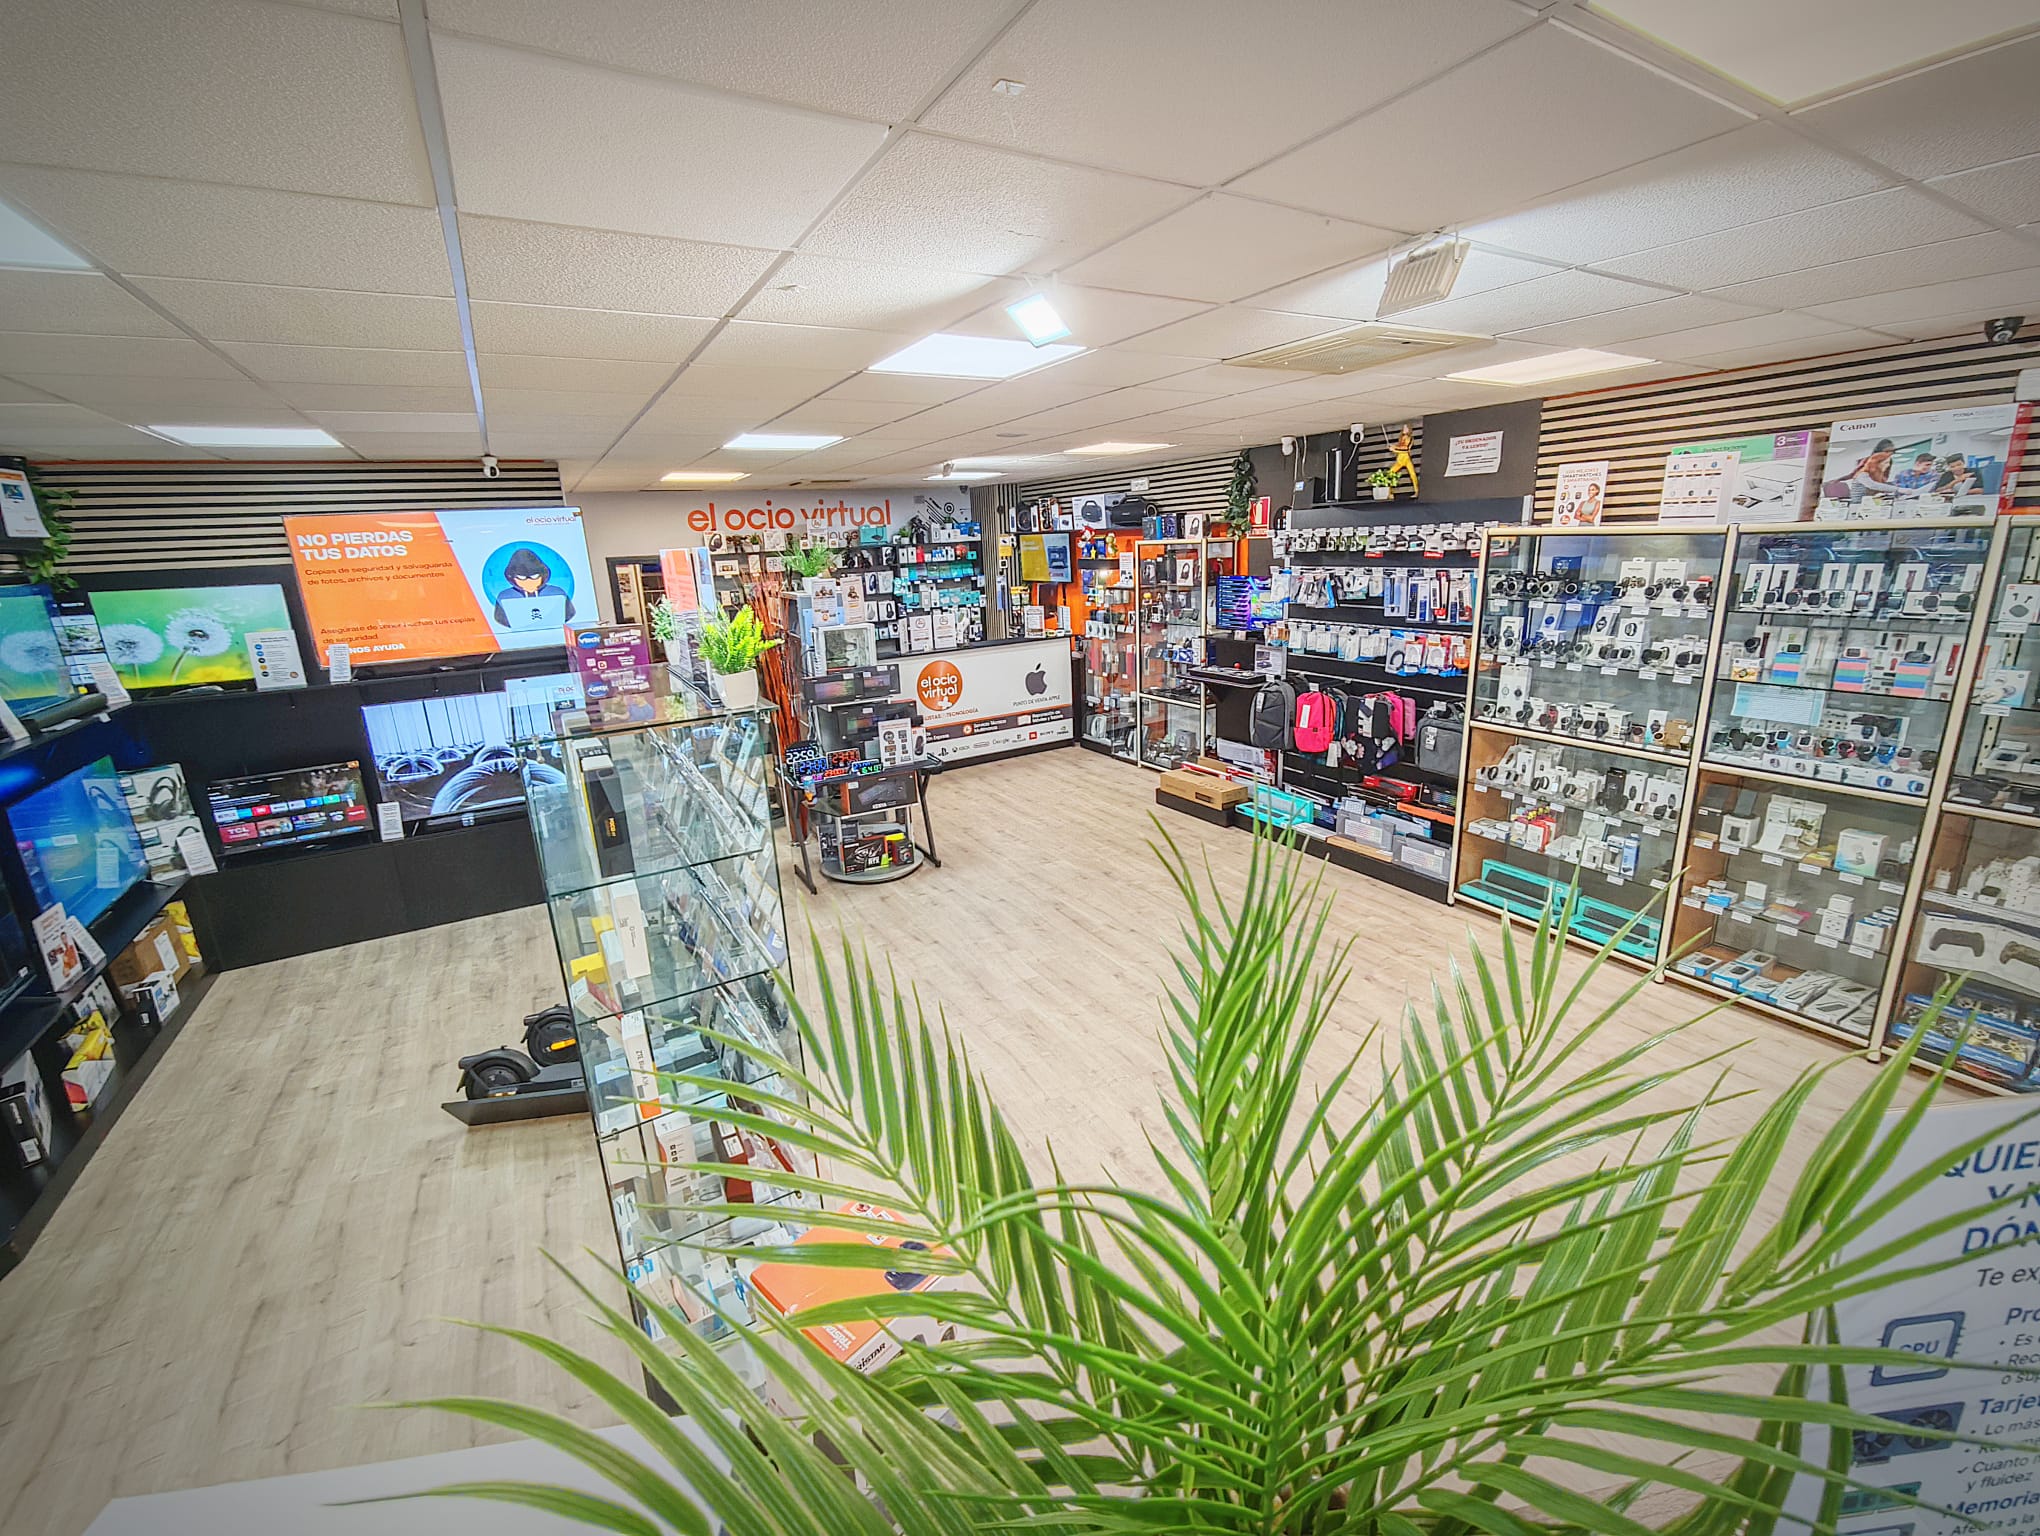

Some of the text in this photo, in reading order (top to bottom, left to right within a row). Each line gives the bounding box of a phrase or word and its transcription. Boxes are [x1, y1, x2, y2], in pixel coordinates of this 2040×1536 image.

[1839, 422, 1877, 433] Canon
[1776, 435, 1787, 447] 3
[687, 498, 893, 532] el ocio virtual
[296, 530, 414, 548] NO PIERDAS
[300, 544, 409, 561] TUS DATOS
[304, 568, 337, 577] Copias
[338, 567, 350, 575] de
[352, 565, 394, 575] seguridad
[403, 562, 454, 571] salvaguarda
[348, 574, 384, 583] archivos
[392, 572, 445, 581] documentos
[367, 623, 378, 631] de
[322, 633, 378, 645] de seguridad
[373, 642, 406, 653] AYUDA
[920, 673, 958, 688] el ocio
[922, 685, 958, 699] virtual
[227, 827, 249, 835] TCL
[1944, 1140, 2040, 1178] QUIE
[1962, 1215, 2040, 1255] DÓN
[1977, 1265, 2040, 1288] Te ex
[2013, 1333, 2034, 1347] Es
[1984, 1423, 2005, 1436] Lo
[1972, 1456, 2030, 1473] Cuanto
[1964, 1471, 2034, 1493] y fluidez
